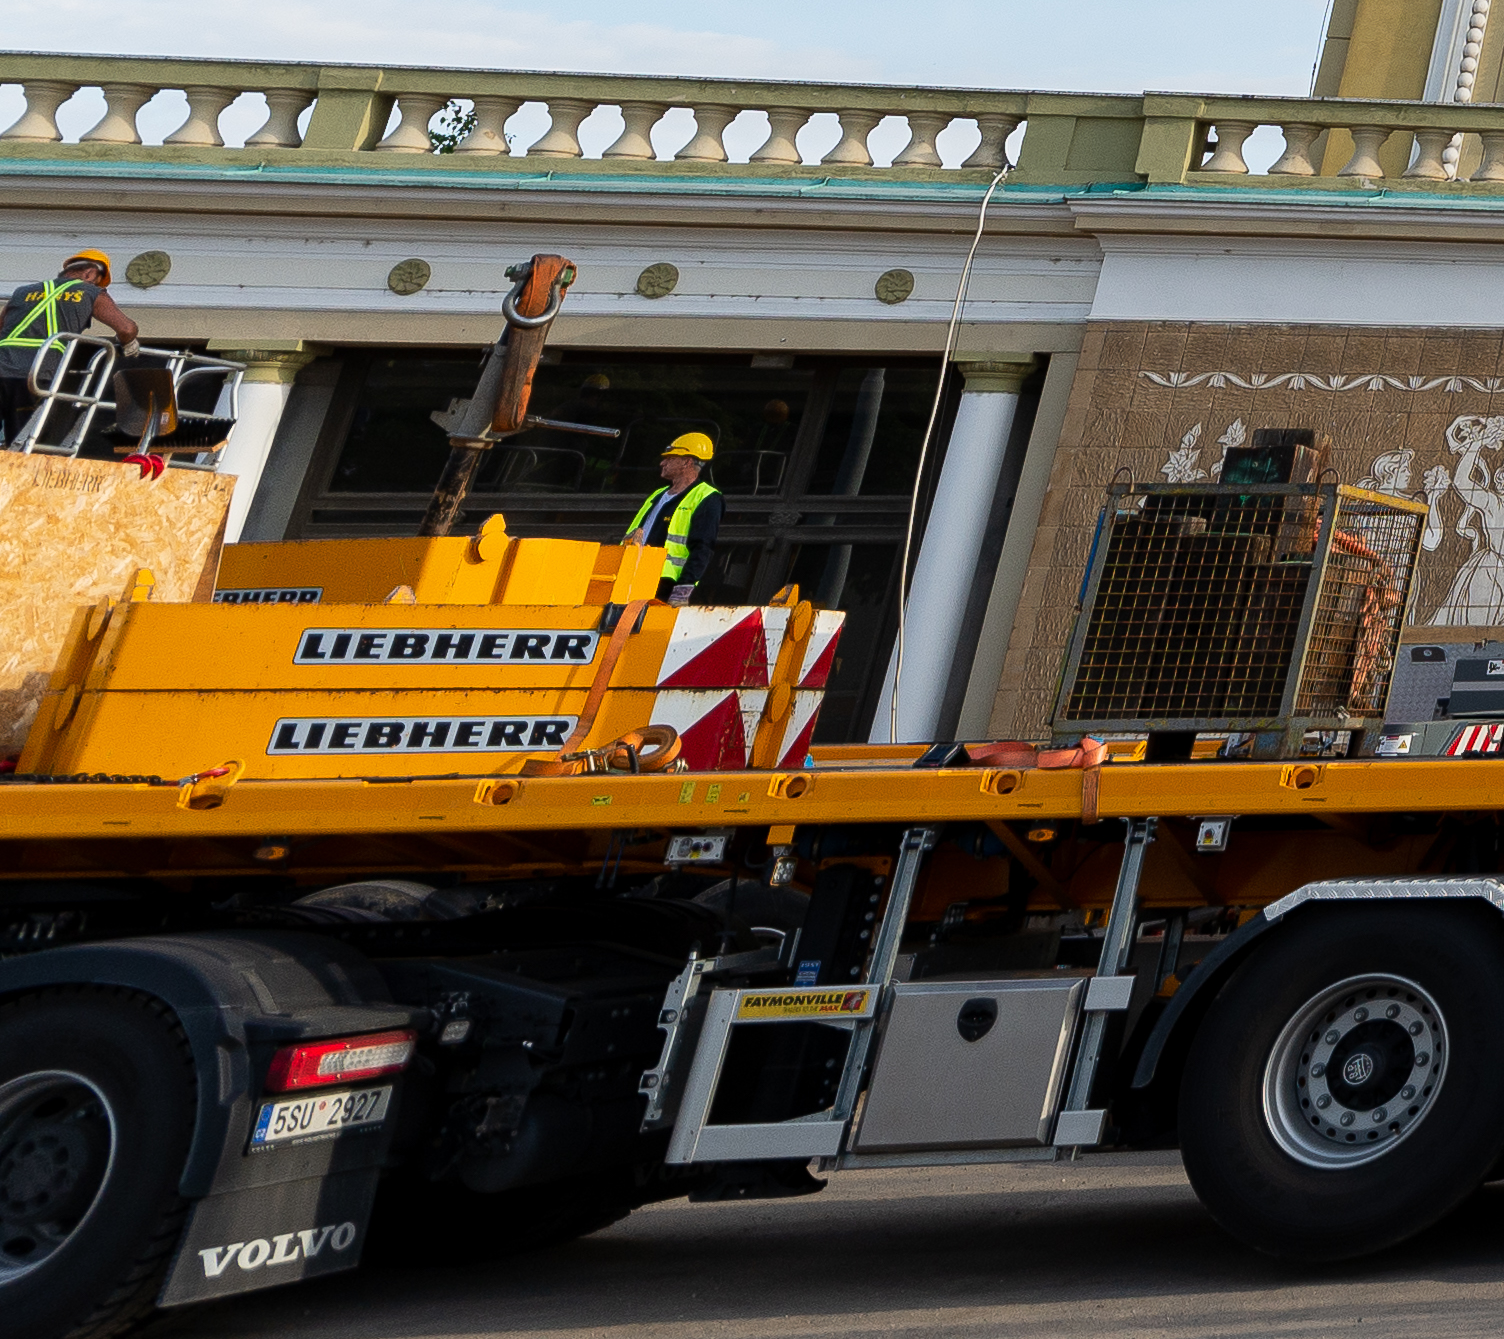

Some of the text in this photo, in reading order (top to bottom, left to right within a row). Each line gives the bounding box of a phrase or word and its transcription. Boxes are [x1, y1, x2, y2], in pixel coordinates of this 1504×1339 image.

[300, 633, 592, 660] LIEBHERR
[273, 720, 570, 751] LIEBHERR
[744, 993, 844, 1007] FAYMONVILLE
[273, 1090, 382, 1134] 5SU 2927
[198, 1222, 356, 1277] VOLVO
